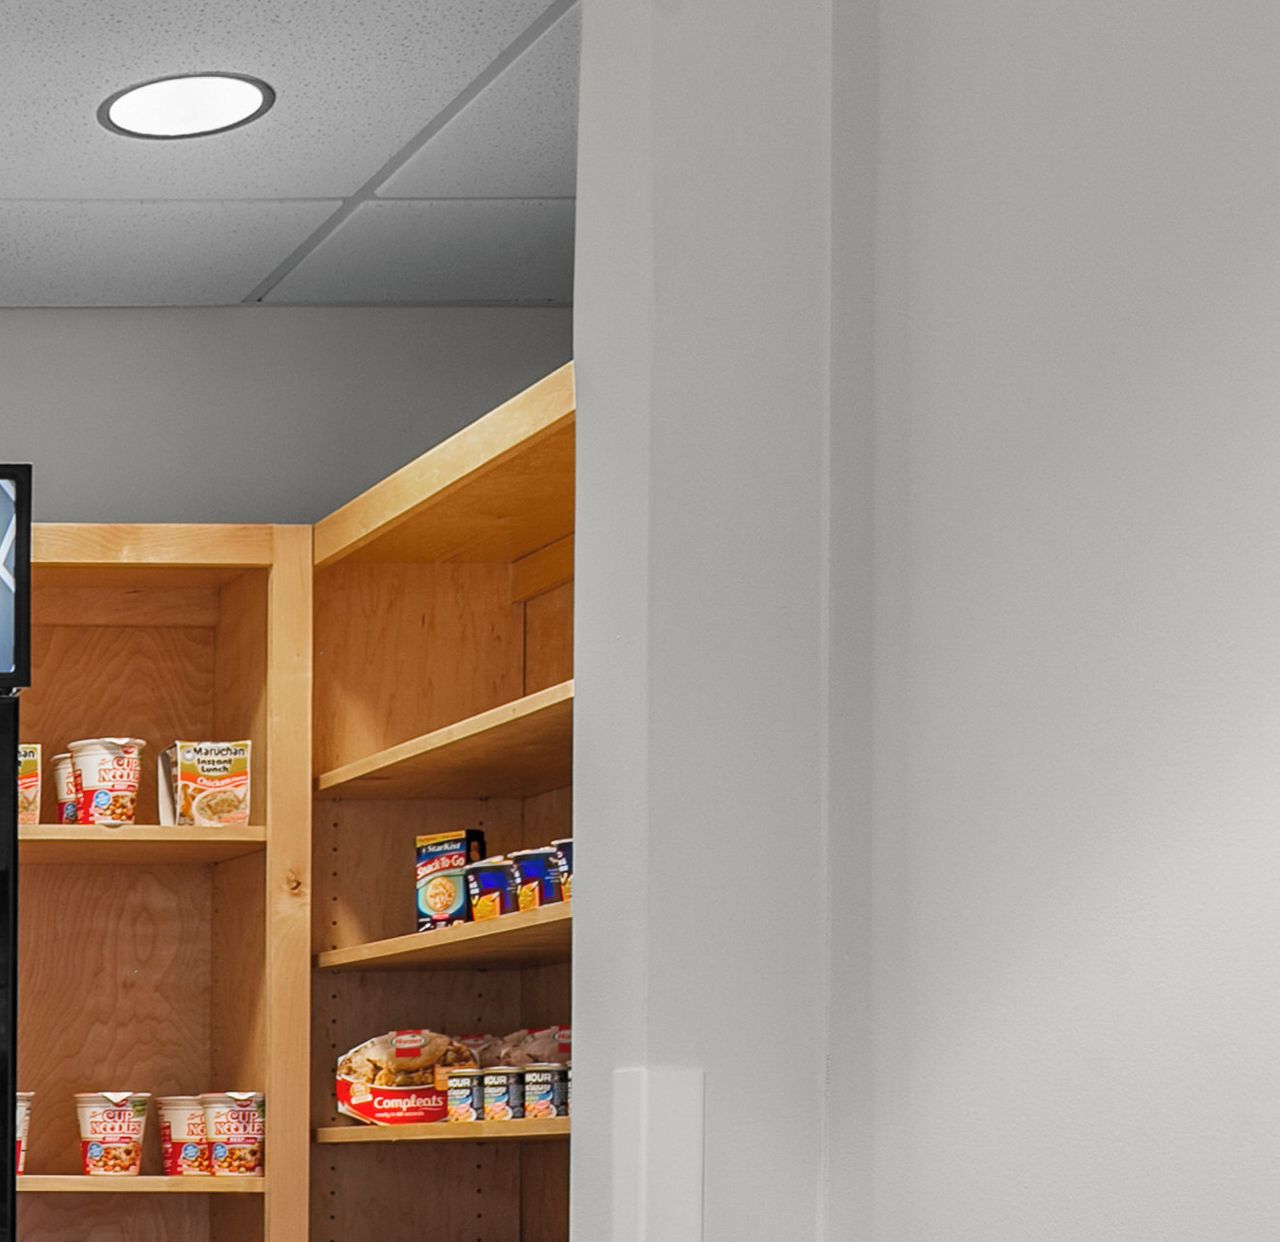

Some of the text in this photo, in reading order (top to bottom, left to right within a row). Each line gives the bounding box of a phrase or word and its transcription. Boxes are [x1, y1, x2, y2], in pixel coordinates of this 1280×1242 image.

[193, 747, 245, 757] Maruchan
[374, 1094, 444, 1111] Compleats
[103, 1110, 134, 1122] CUP
[228, 1110, 258, 1122] CUP
